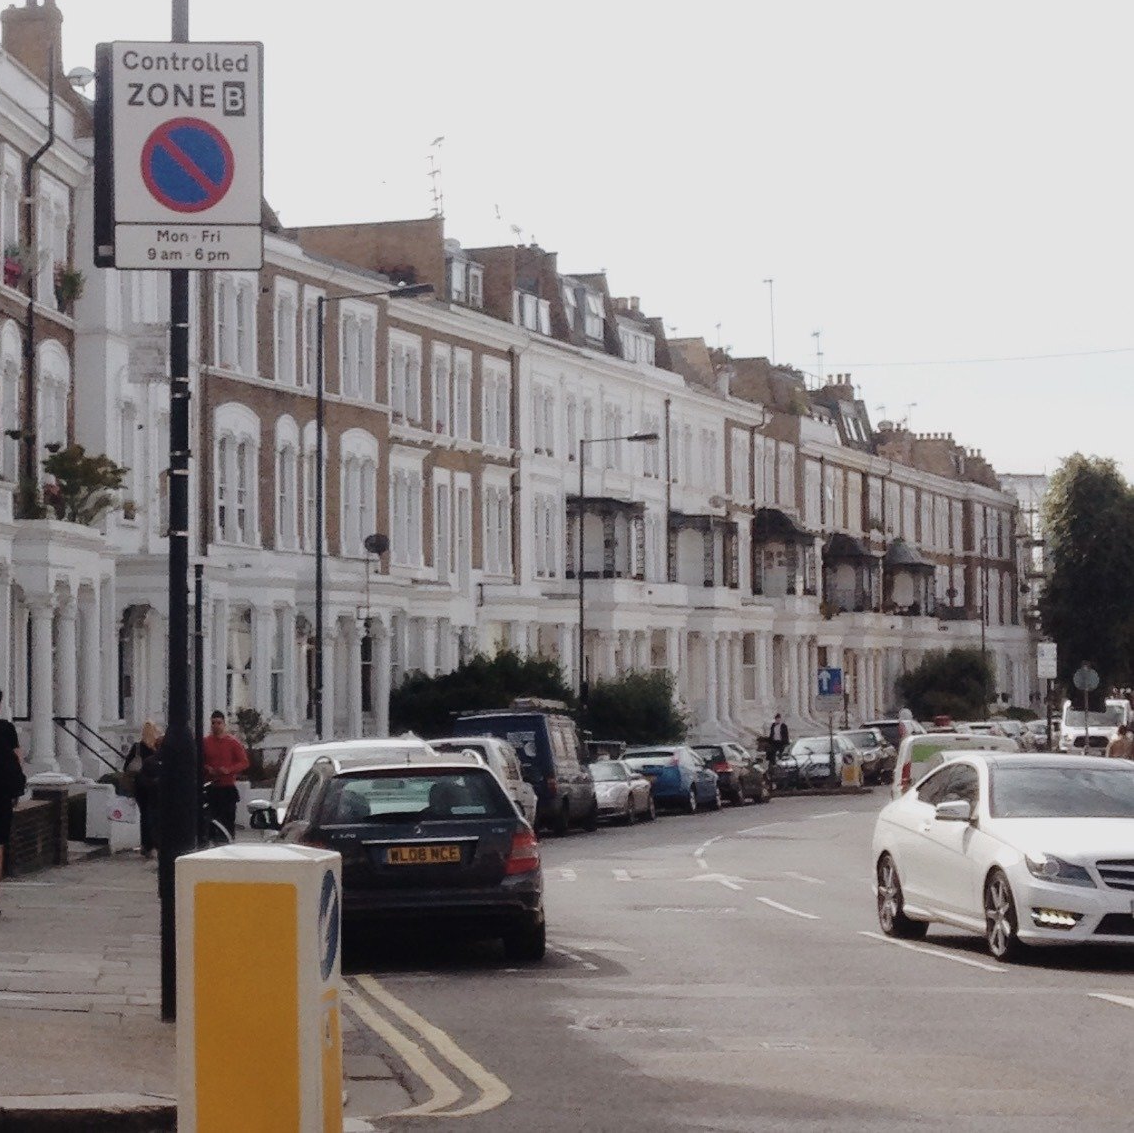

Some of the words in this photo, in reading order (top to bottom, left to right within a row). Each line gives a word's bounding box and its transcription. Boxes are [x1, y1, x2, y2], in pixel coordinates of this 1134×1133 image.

[122, 50, 249, 72] Controlled
[127, 82, 216, 108] ZONE
[156, 229, 189, 243] Mon
[201, 230, 221, 243] Fri
